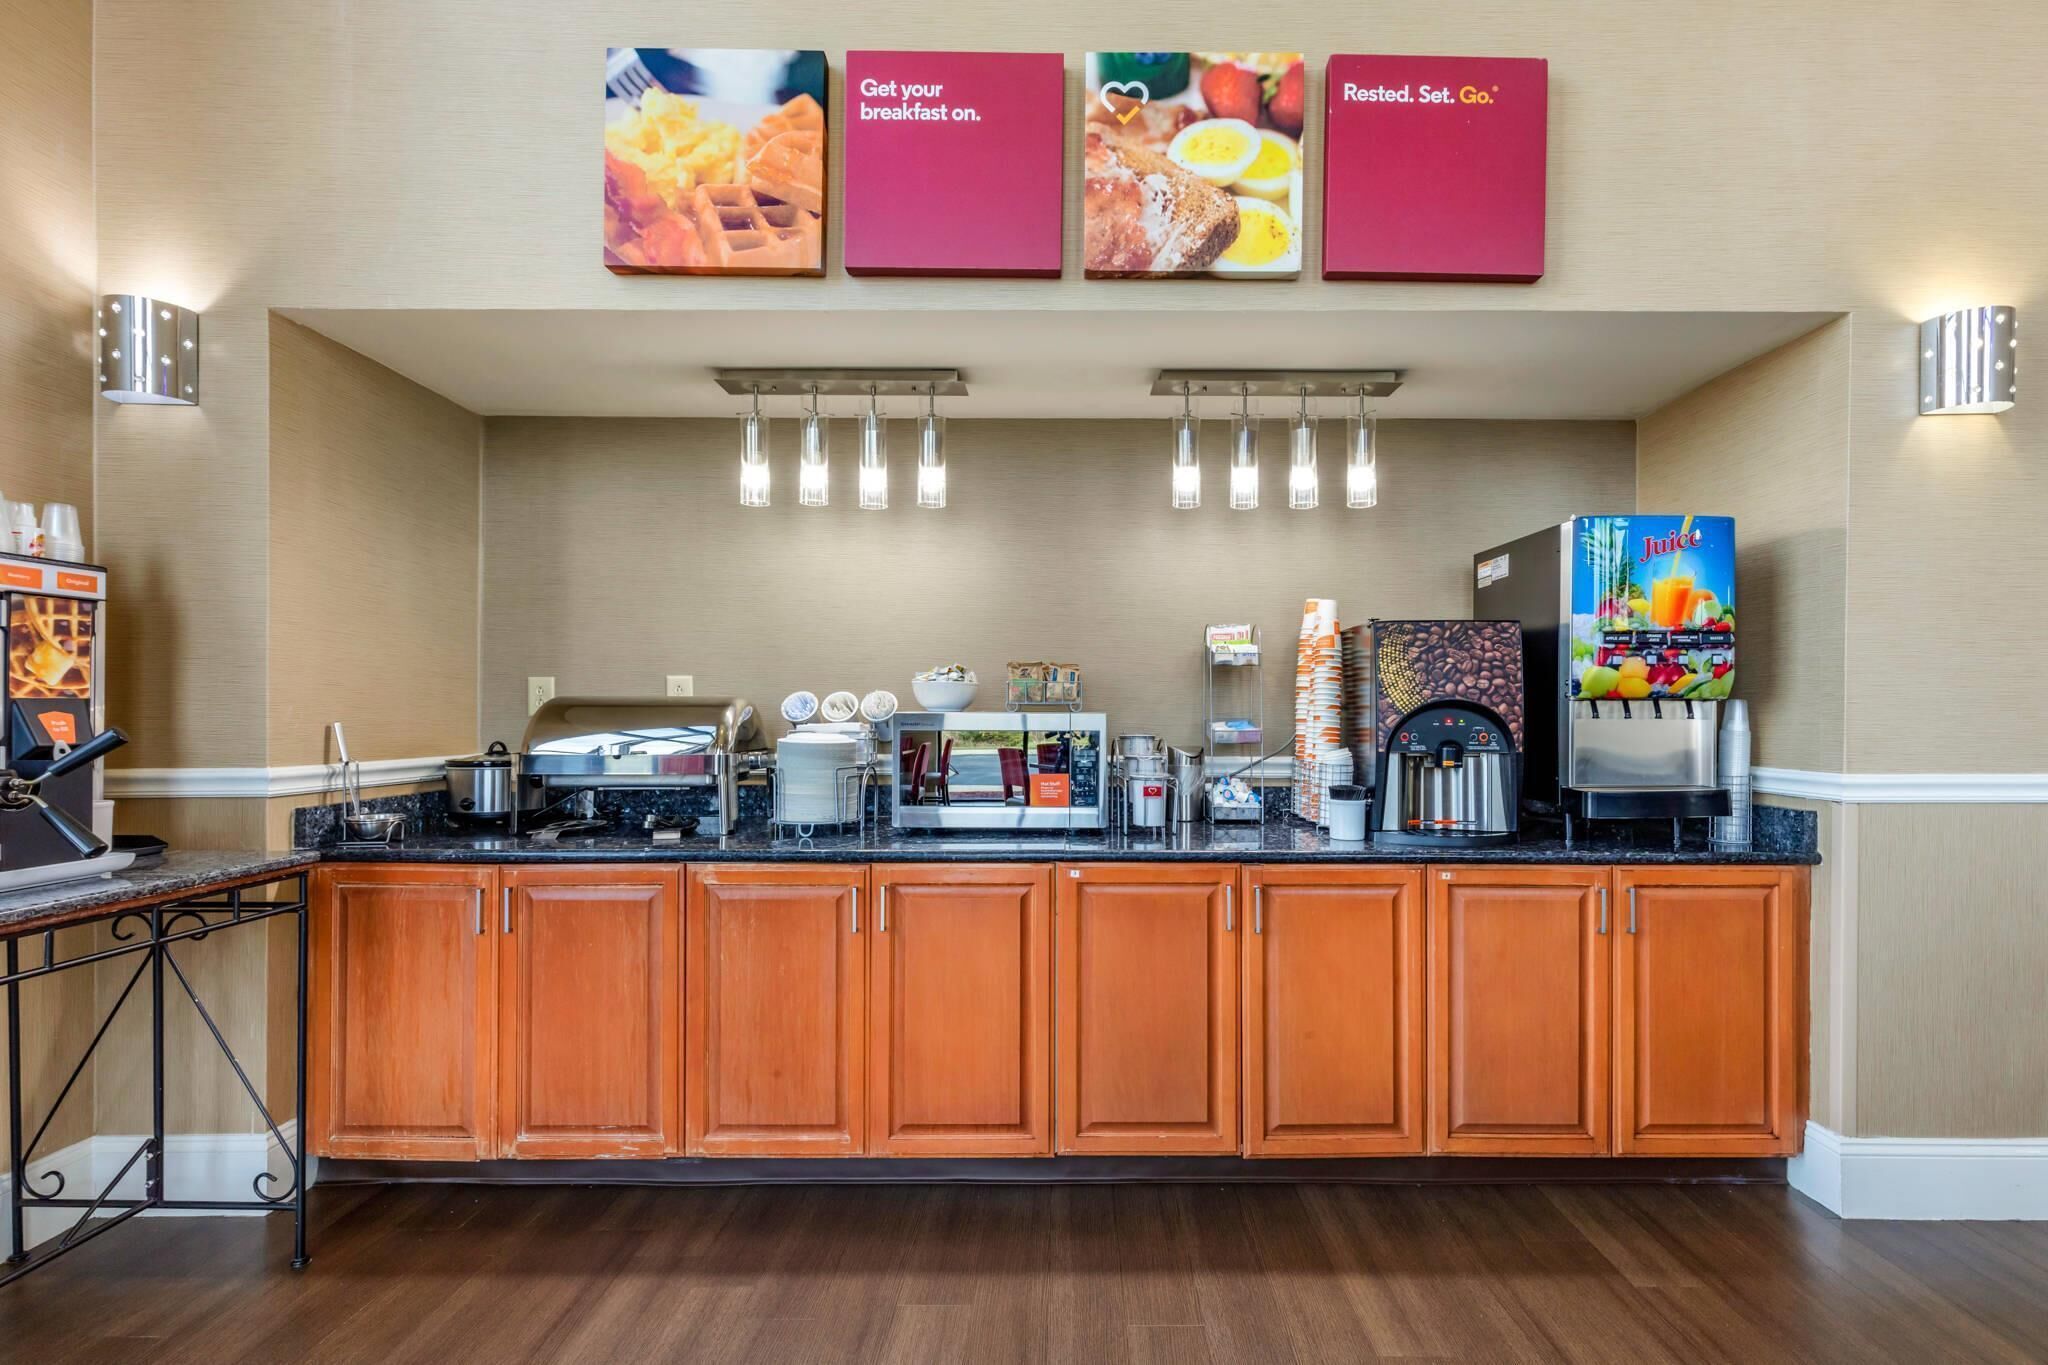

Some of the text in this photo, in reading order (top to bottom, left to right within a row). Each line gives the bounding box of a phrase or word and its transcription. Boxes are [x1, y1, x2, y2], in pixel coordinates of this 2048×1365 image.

[860, 78, 943, 101] Get your
[1343, 82, 1414, 103] Rested.
[1418, 84, 1455, 104] Set.
[860, 102, 982, 121] breakfast on.
[1639, 529, 1702, 563] Juice
